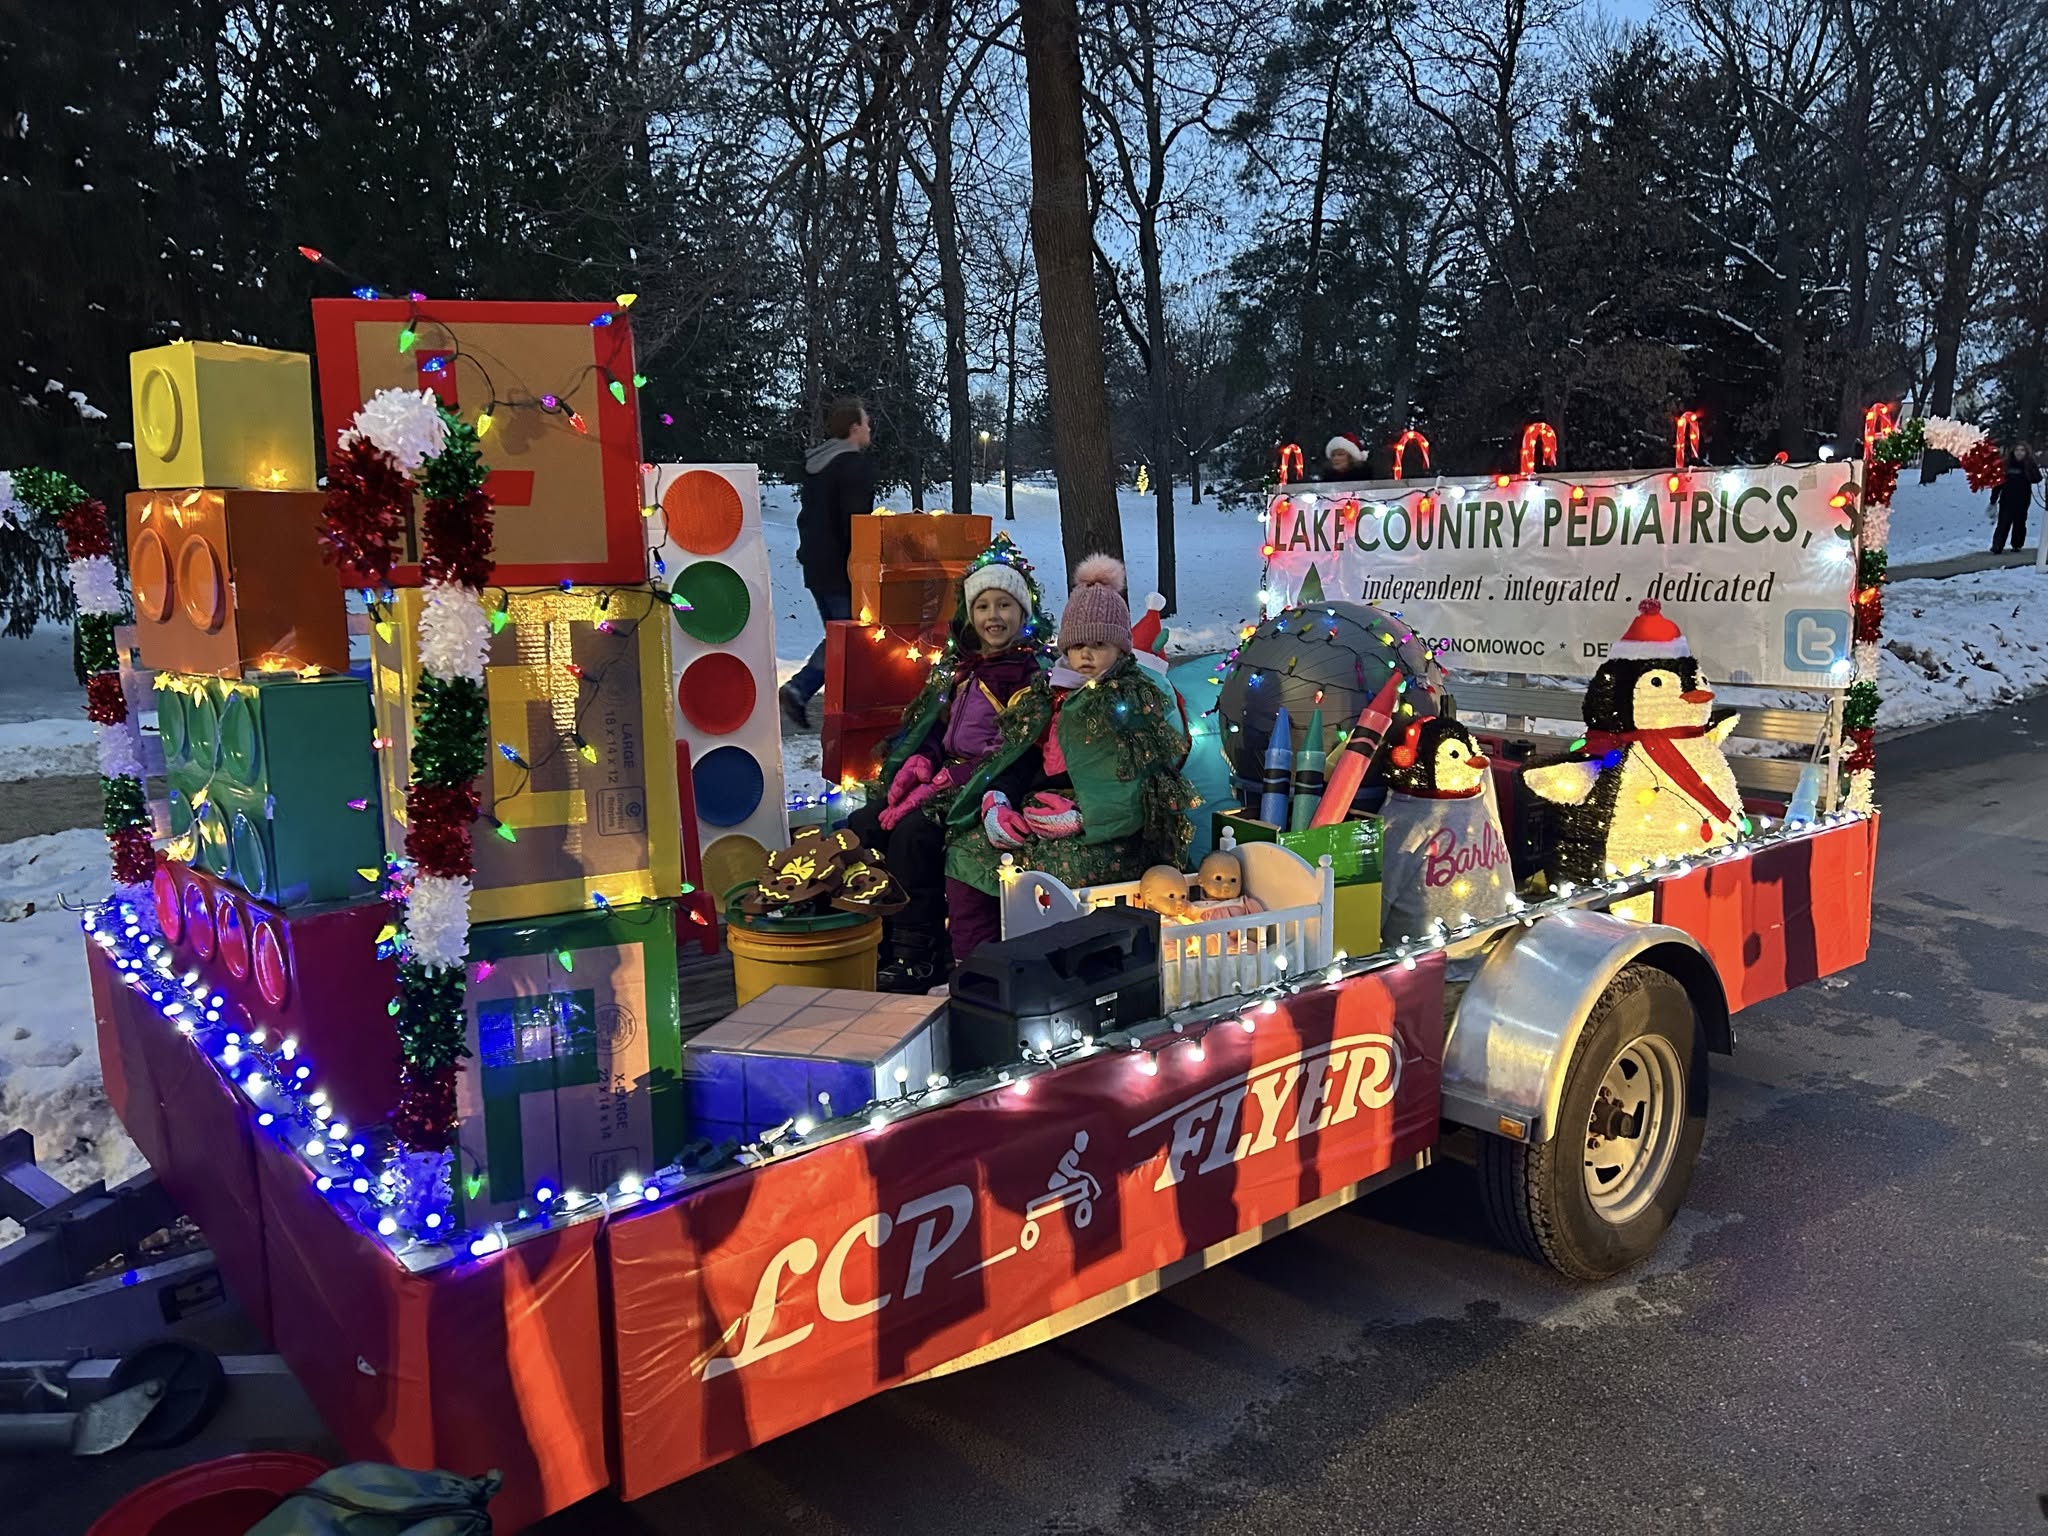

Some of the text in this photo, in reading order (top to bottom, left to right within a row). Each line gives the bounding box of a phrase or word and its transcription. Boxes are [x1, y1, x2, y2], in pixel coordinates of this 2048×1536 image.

[1273, 505, 1345, 552] LAKE
[1354, 500, 1530, 552] COUNTRY
[1542, 484, 1813, 549] PEDIATRICS,
[1361, 573, 1483, 603] independent
[1504, 572, 1622, 606] integrated
[1646, 570, 1776, 603] dedicated
[604, 710, 616, 726] 18
[607, 739, 618, 755] 14
[621, 722, 635, 769] LARGE
[608, 769, 619, 784] 12
[614, 1072, 628, 1129] X-LARGE
[700, 1032, 1403, 1382] LCP FLYER
